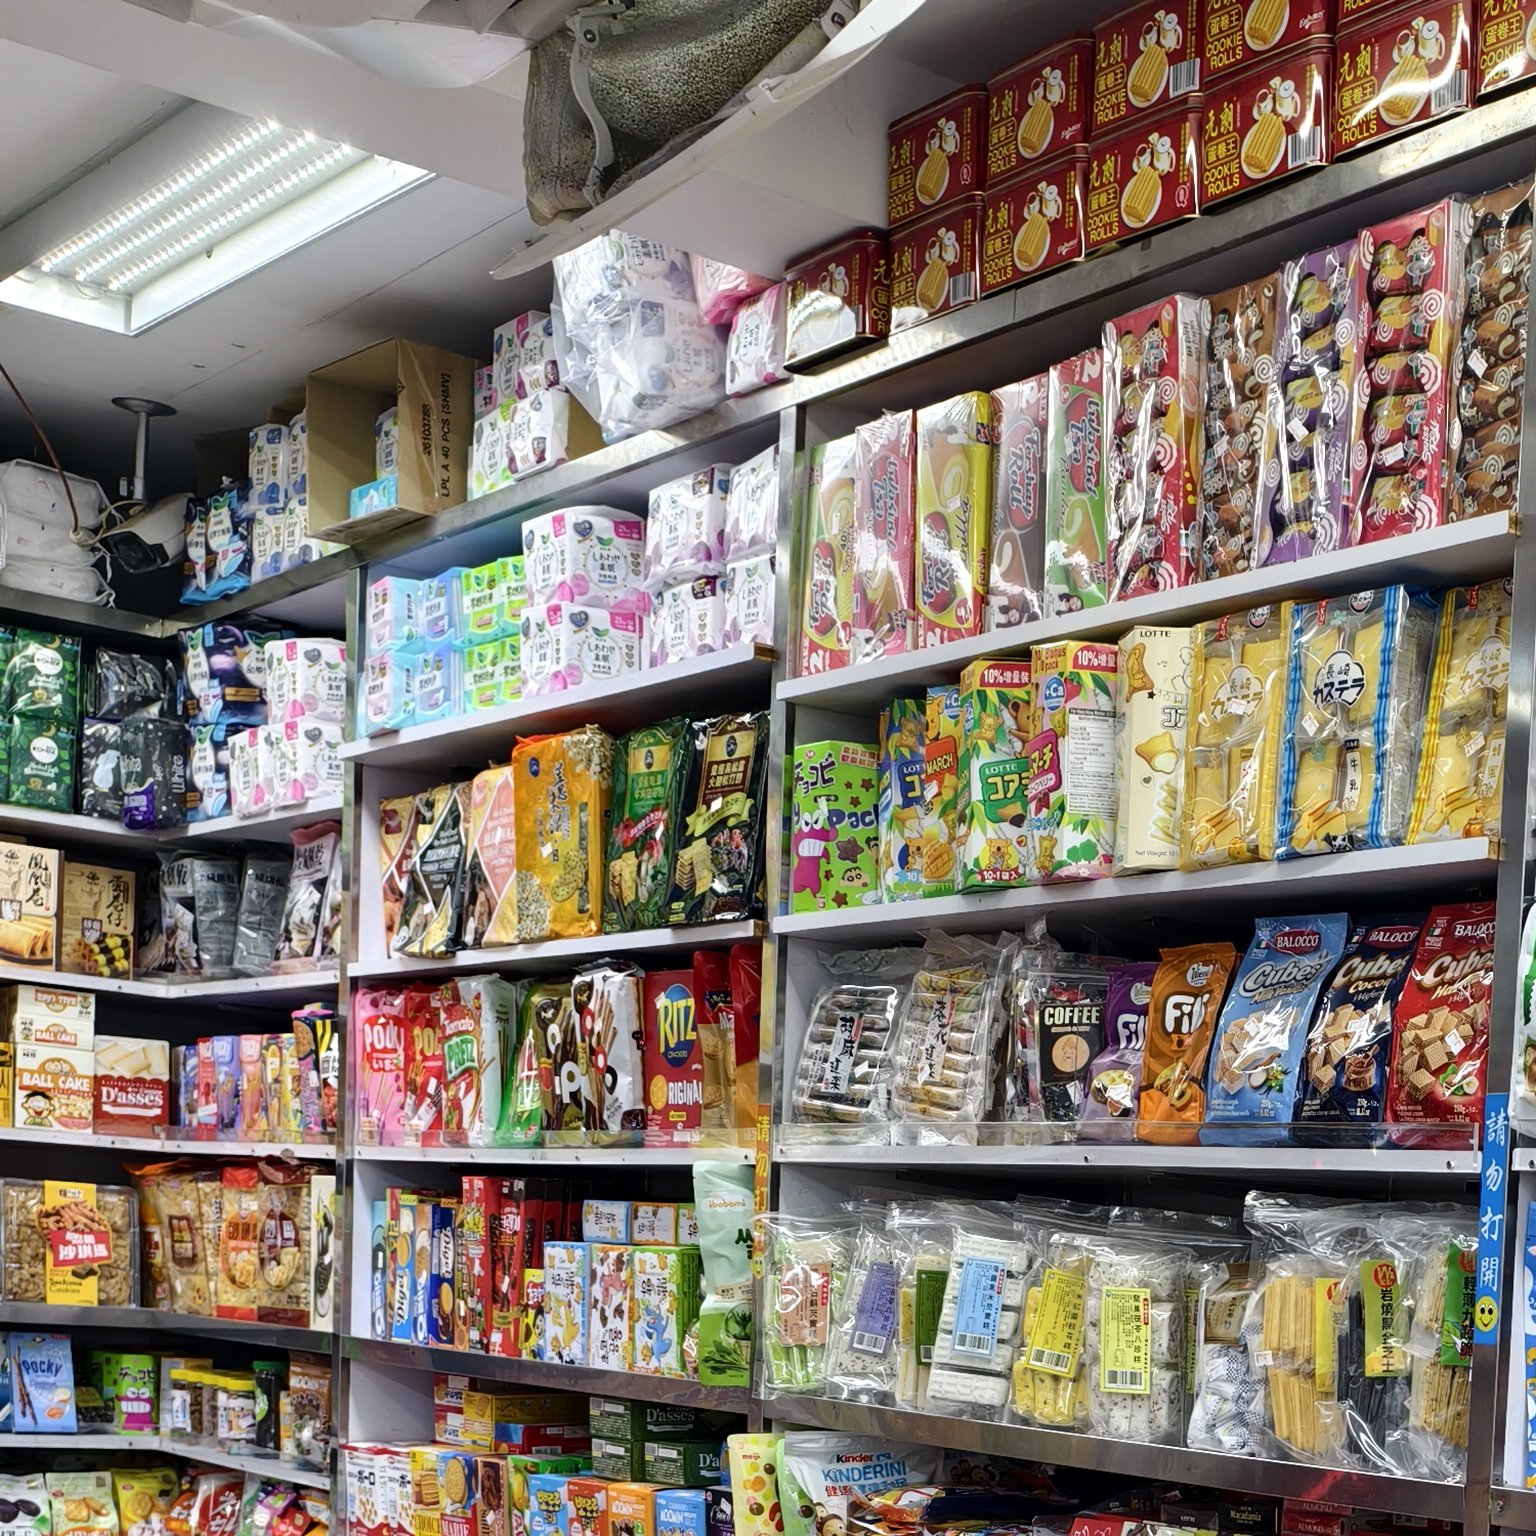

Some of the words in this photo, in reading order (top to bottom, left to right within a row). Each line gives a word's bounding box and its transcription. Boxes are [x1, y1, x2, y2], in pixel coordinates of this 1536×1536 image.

[1206, 34, 1243, 58] COOKIE
[1210, 46, 1243, 70] ROLLS
[1094, 89, 1126, 115] COOKIE
[1341, 119, 1377, 145] ROLLS
[1203, 159, 1241, 185] COOKIE
[1206, 175, 1240, 197] ROLLS
[1139, 630, 1172, 639] LOTTE
[1310, 677, 1368, 706] カステラ
[926, 751, 955, 776] MARCH
[985, 762, 1018, 775] LOTTE
[1276, 932, 1320, 950] BALOCCO
[1239, 962, 1322, 997] Cubes
[658, 996, 697, 1055] RITZ
[1044, 1005, 1101, 1026] COFFEE
[22, 1072, 54, 1088] BALL
[101, 1086, 164, 1107] D'asses
[1480, 1112, 1510, 1292] 請勿打開
[645, 1406, 696, 1423] D'asses
